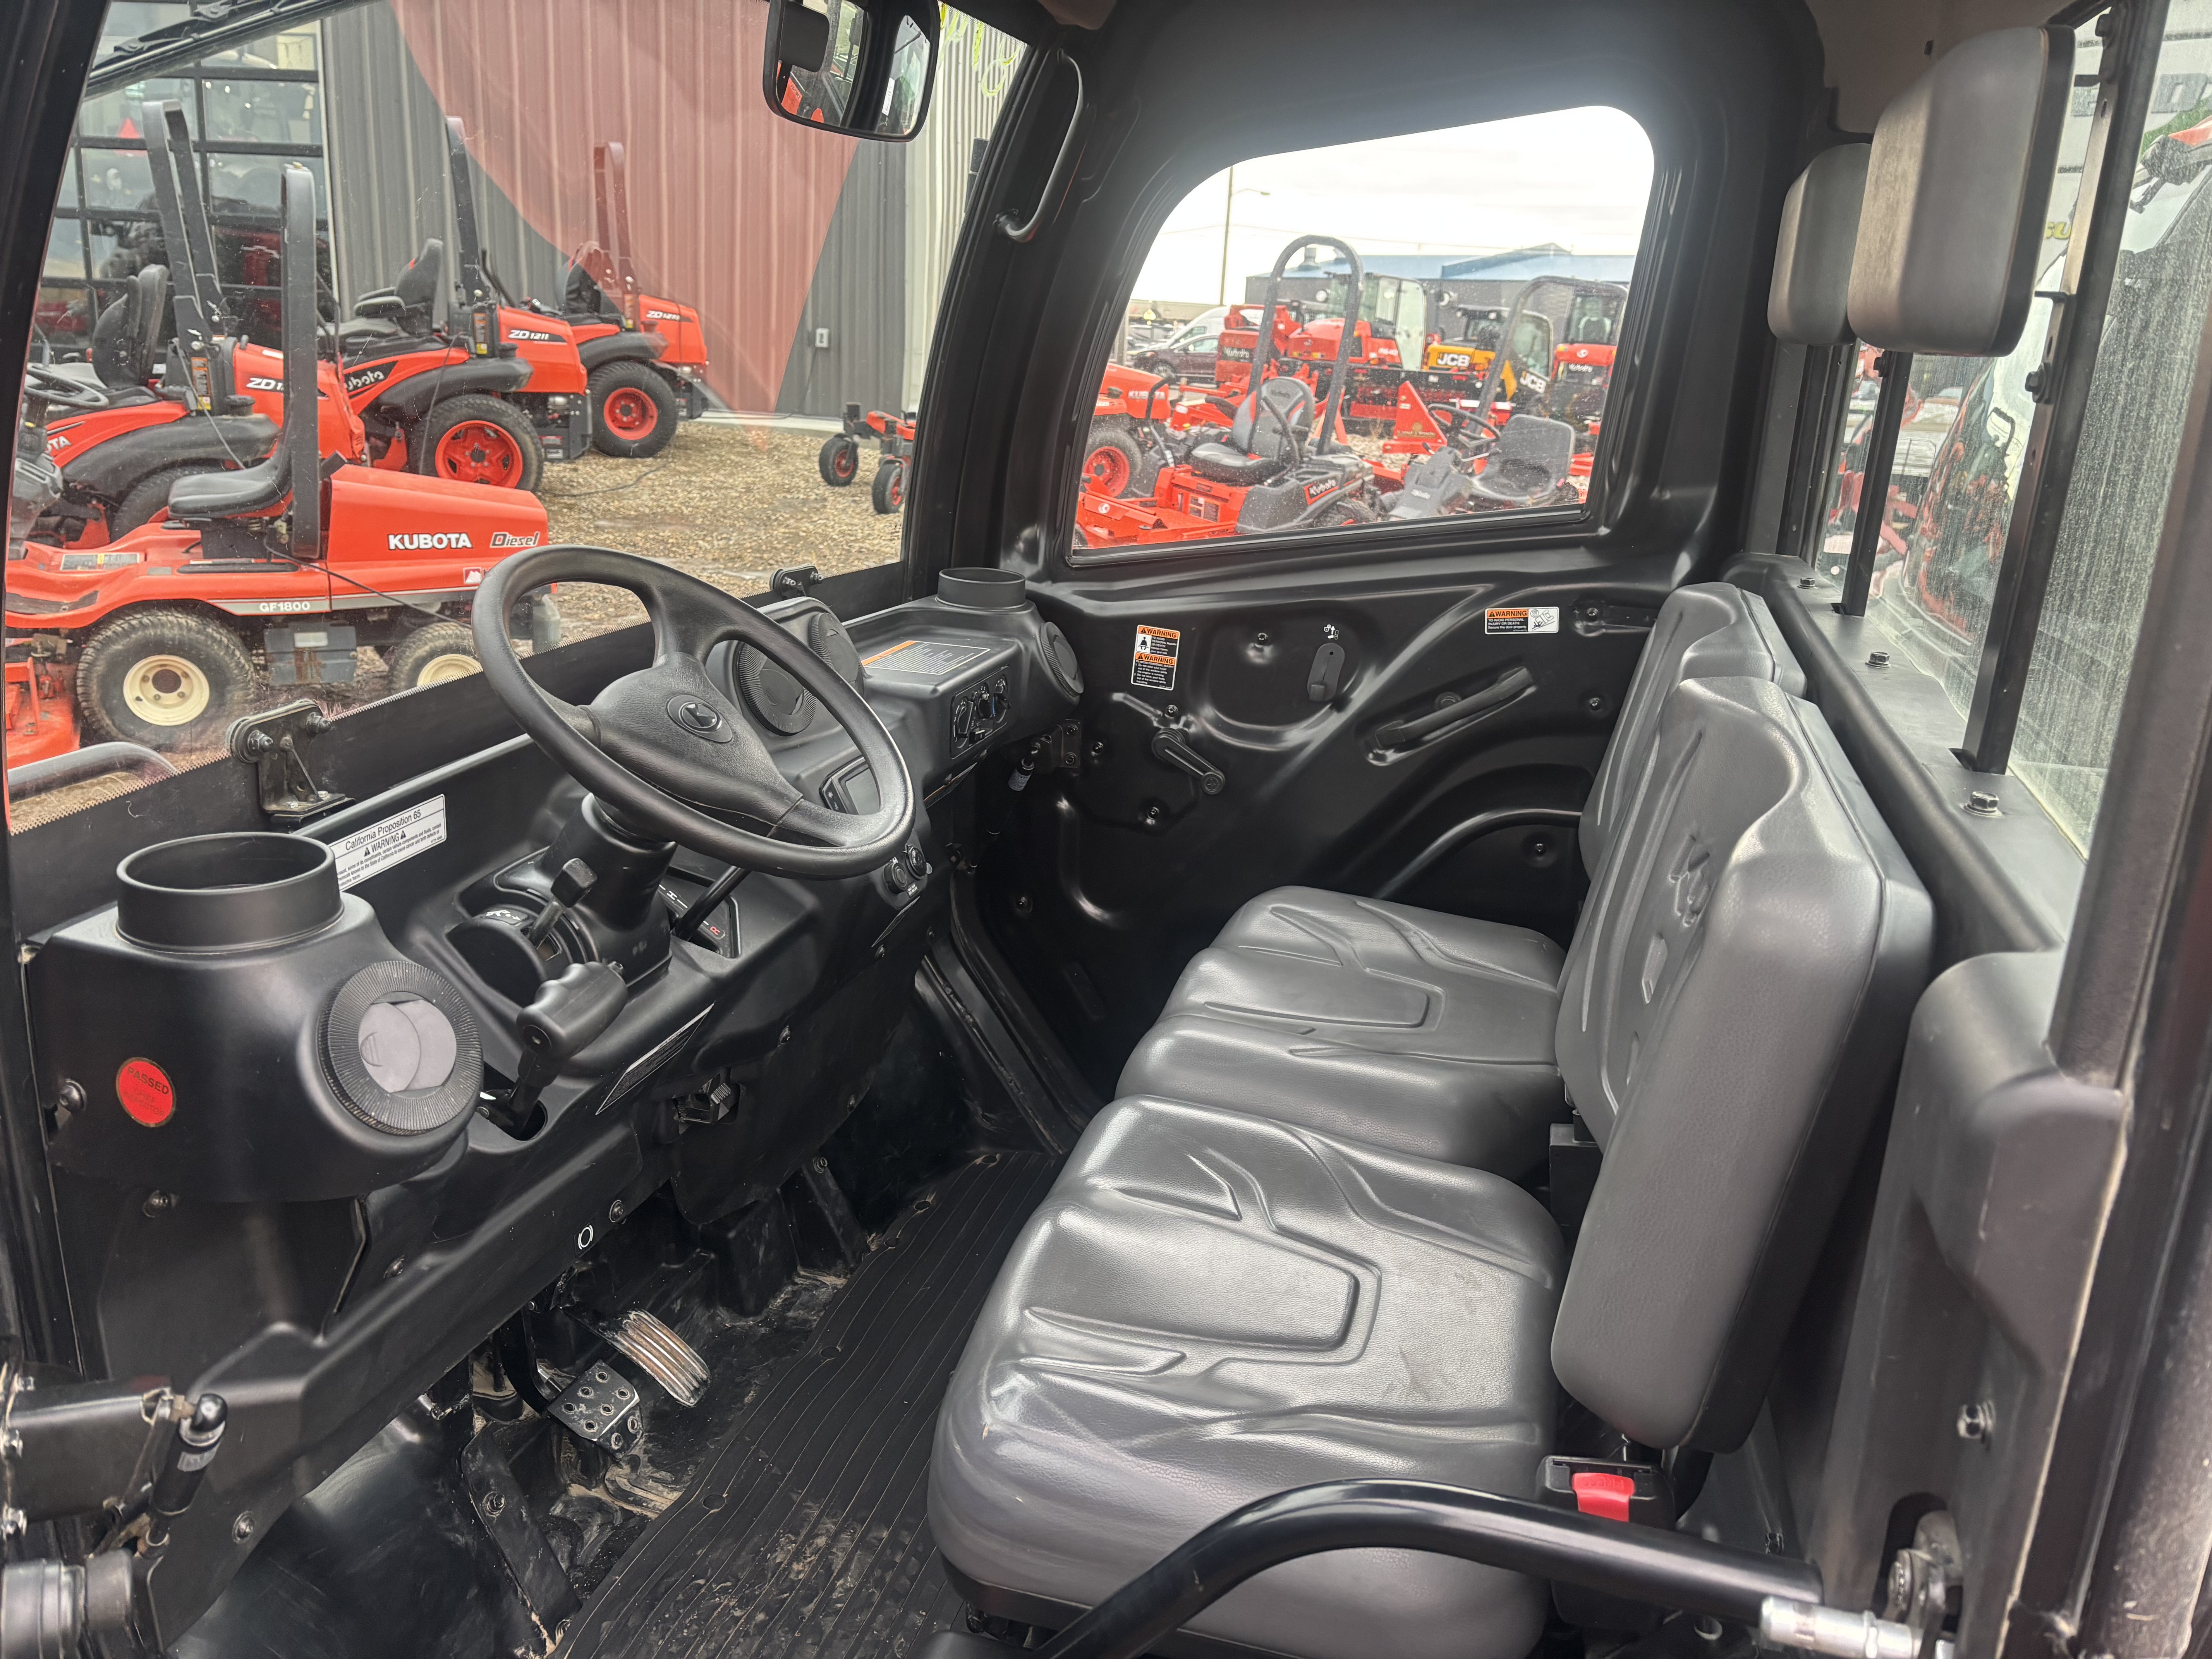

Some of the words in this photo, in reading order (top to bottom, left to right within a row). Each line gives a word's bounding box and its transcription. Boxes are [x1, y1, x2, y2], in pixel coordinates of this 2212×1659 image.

[1437, 353, 1470, 367] JCB
[344, 371, 385, 390] ubota
[1520, 373, 1546, 393] JCB
[388, 533, 472, 550] KUBOTA
[491, 532, 539, 547] Diesel
[259, 601, 310, 613] GF1800
[1147, 629, 1176, 638] WARNING
[1144, 655, 1173, 664] WARNING
[345, 830, 376, 851] California
[378, 814, 412, 836] Proposition
[413, 809, 421, 819] 65
[371, 832, 399, 852] WARNING
[666, 891, 677, 900] H
[710, 926, 720, 935] R
[127, 1066, 169, 1095] PASSED
